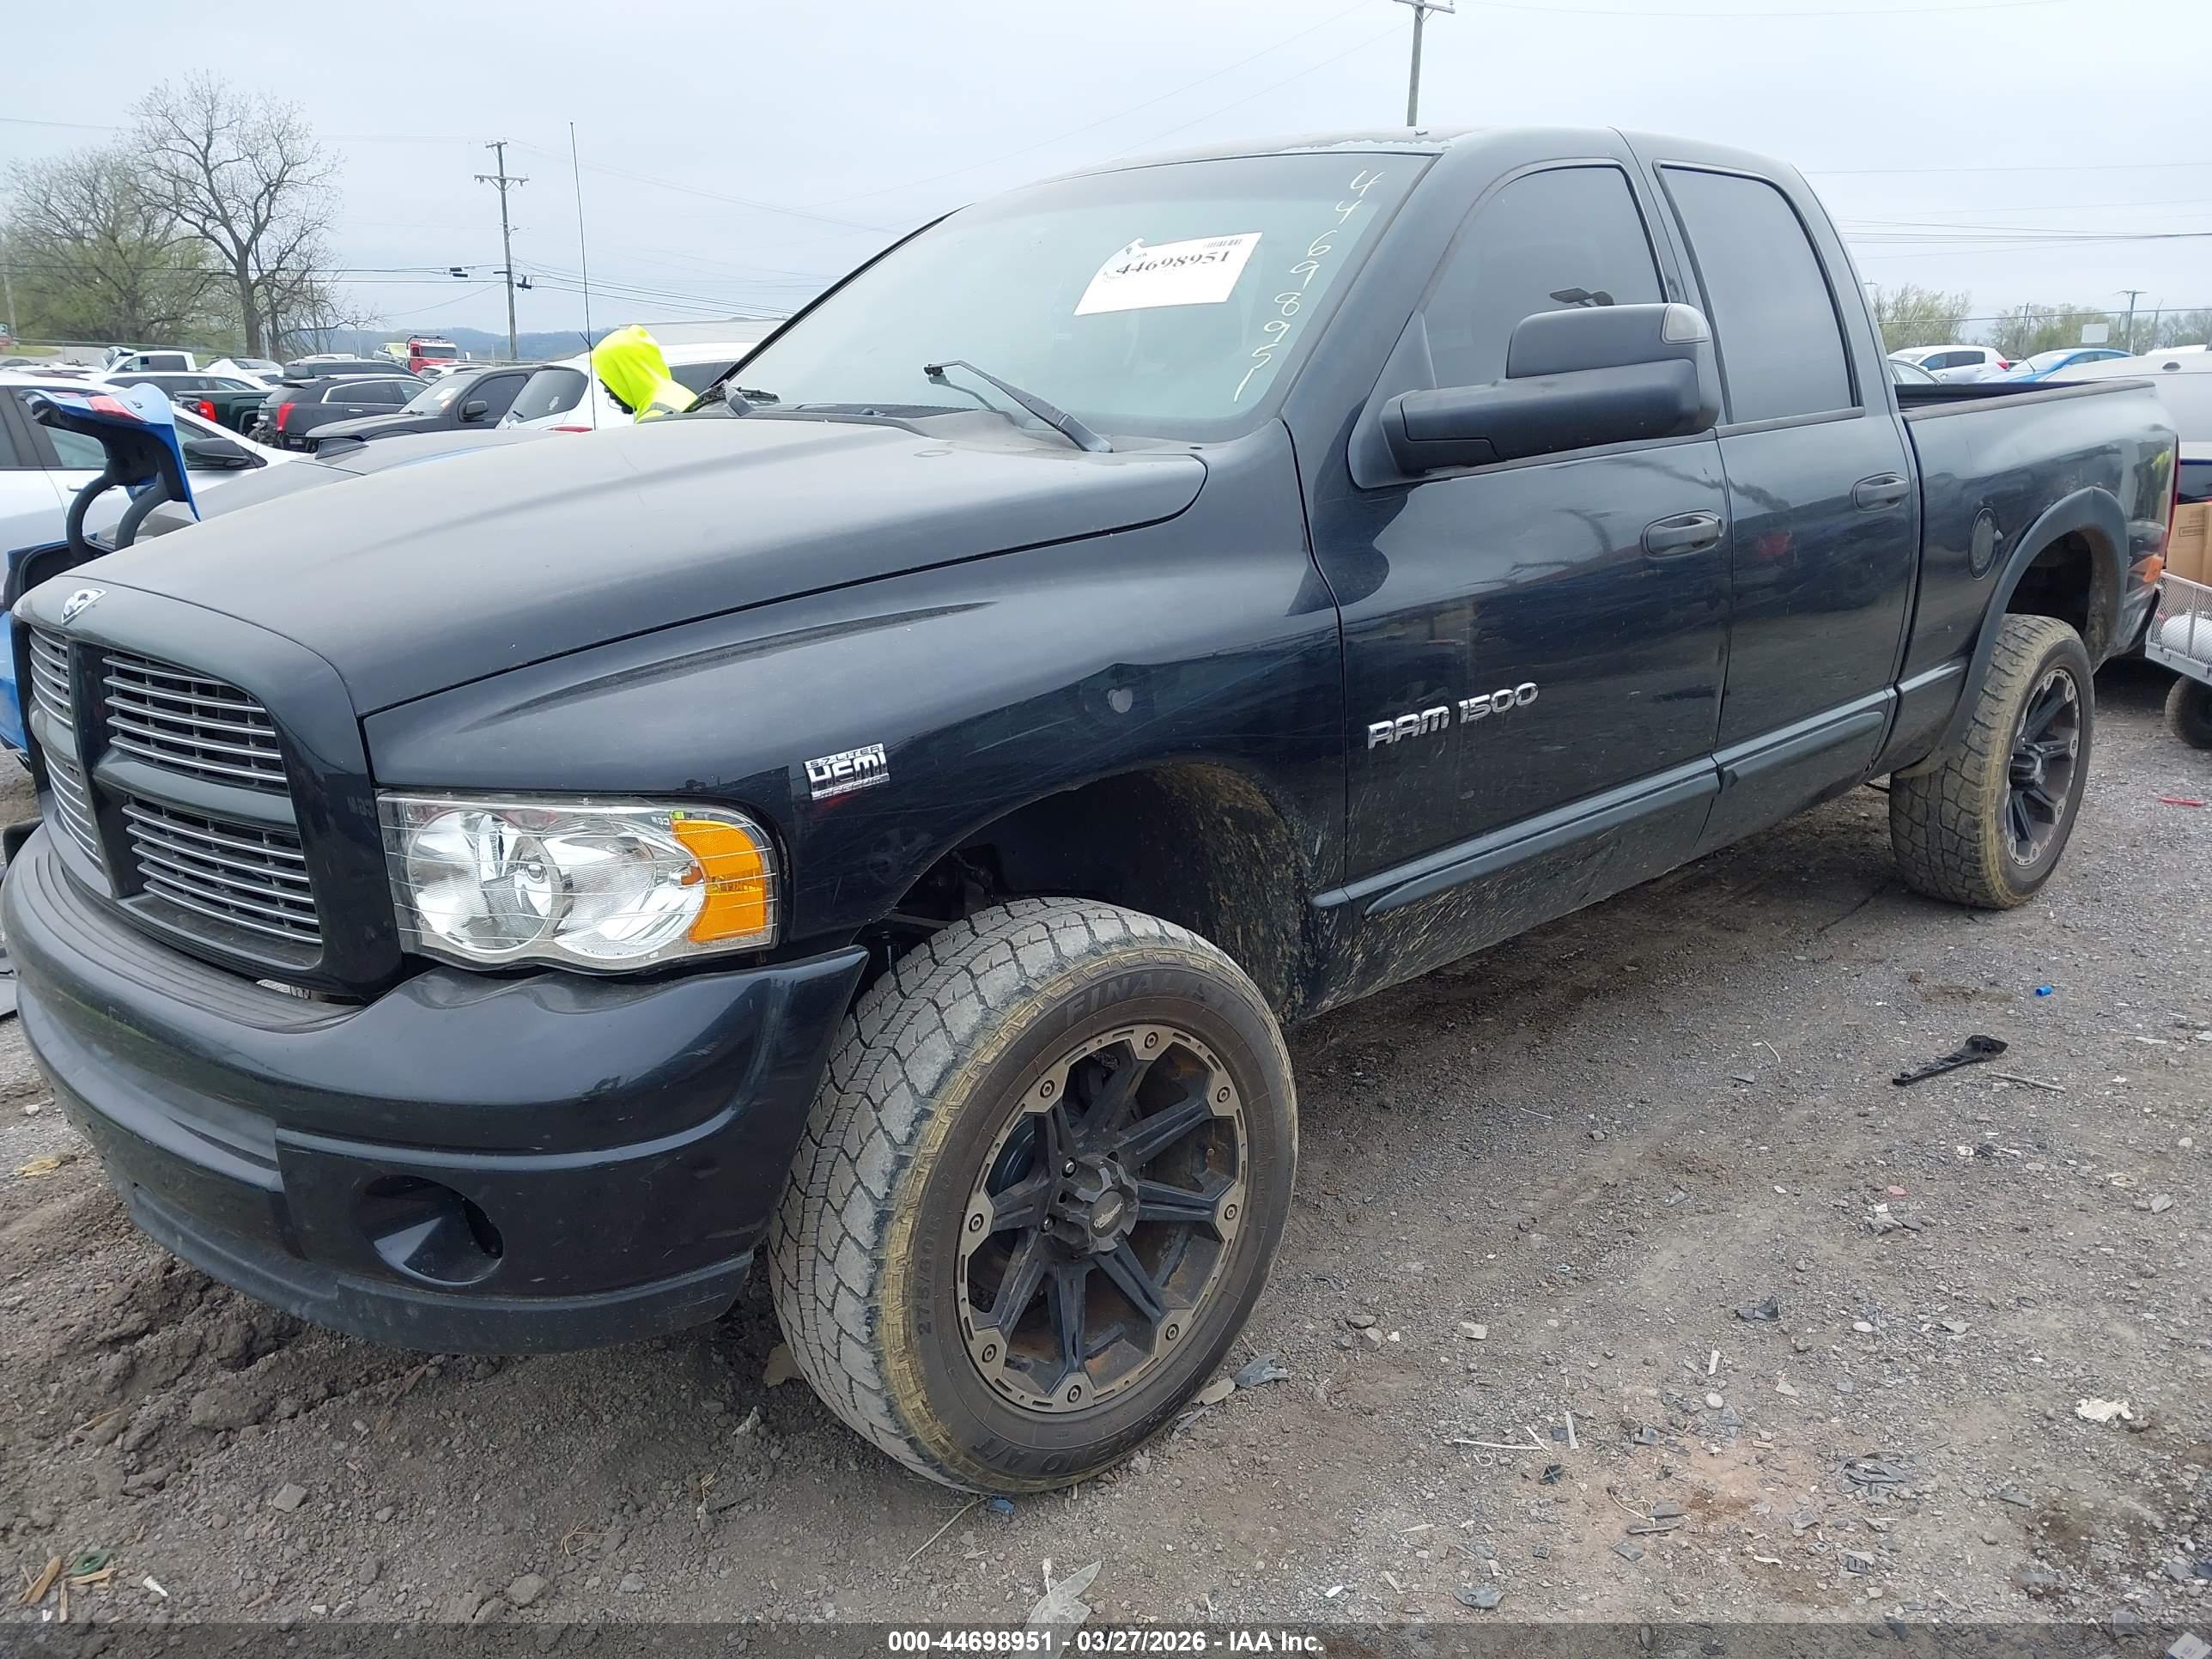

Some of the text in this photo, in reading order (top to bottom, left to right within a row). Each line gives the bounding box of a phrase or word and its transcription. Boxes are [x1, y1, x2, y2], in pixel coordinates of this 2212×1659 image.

[1115, 249, 1231, 276] 44698951
[1233, 170, 1386, 404] 44698951
[1367, 682, 1539, 750] RAM 1500
[807, 751, 888, 793] HEMI
[836, 745, 880, 762] LITER
